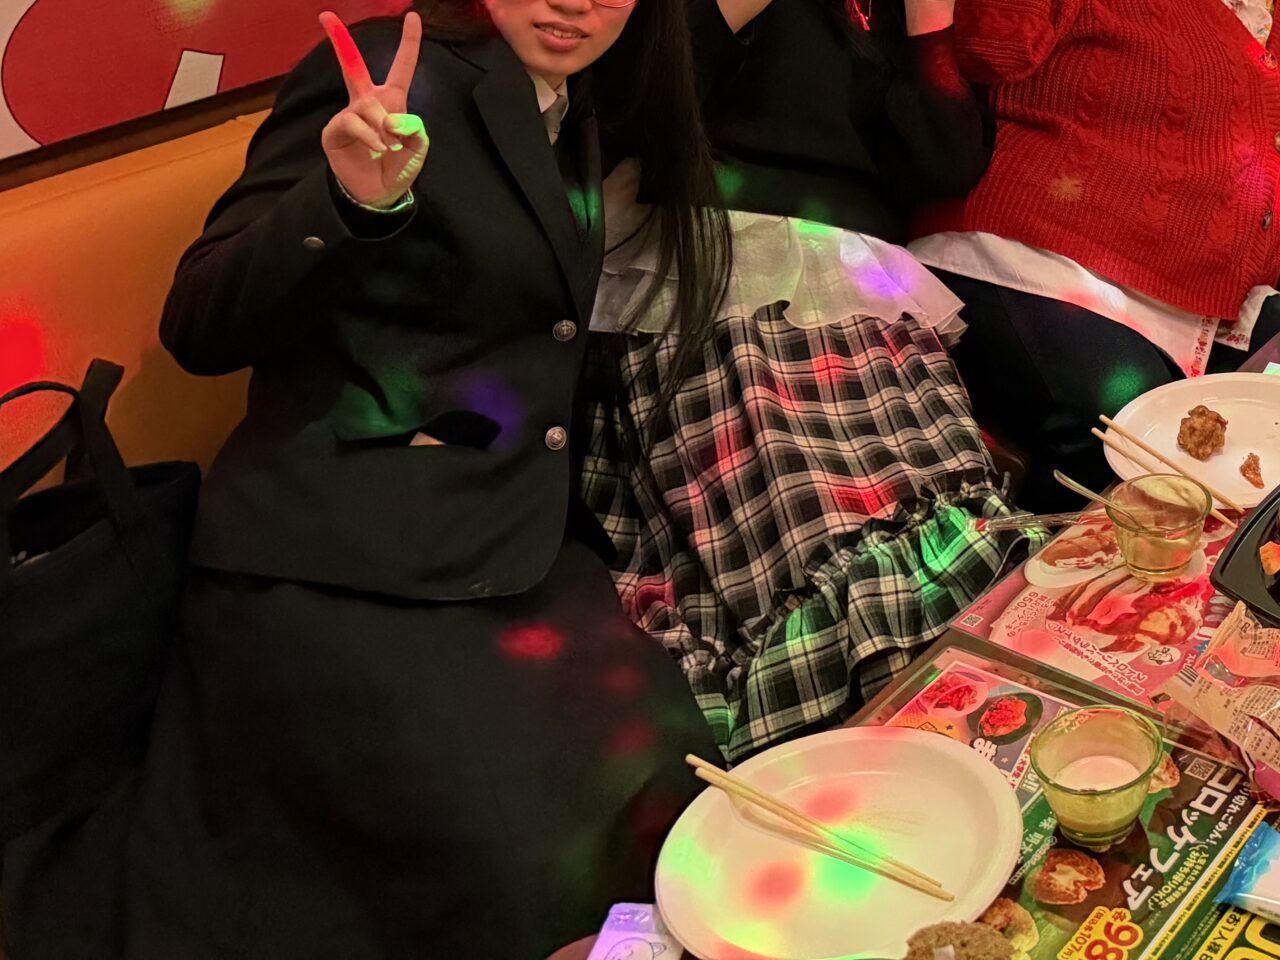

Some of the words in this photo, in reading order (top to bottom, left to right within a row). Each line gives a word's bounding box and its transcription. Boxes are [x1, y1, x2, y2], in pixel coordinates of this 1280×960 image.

[1123, 763, 1242, 911] コロッケフェア
